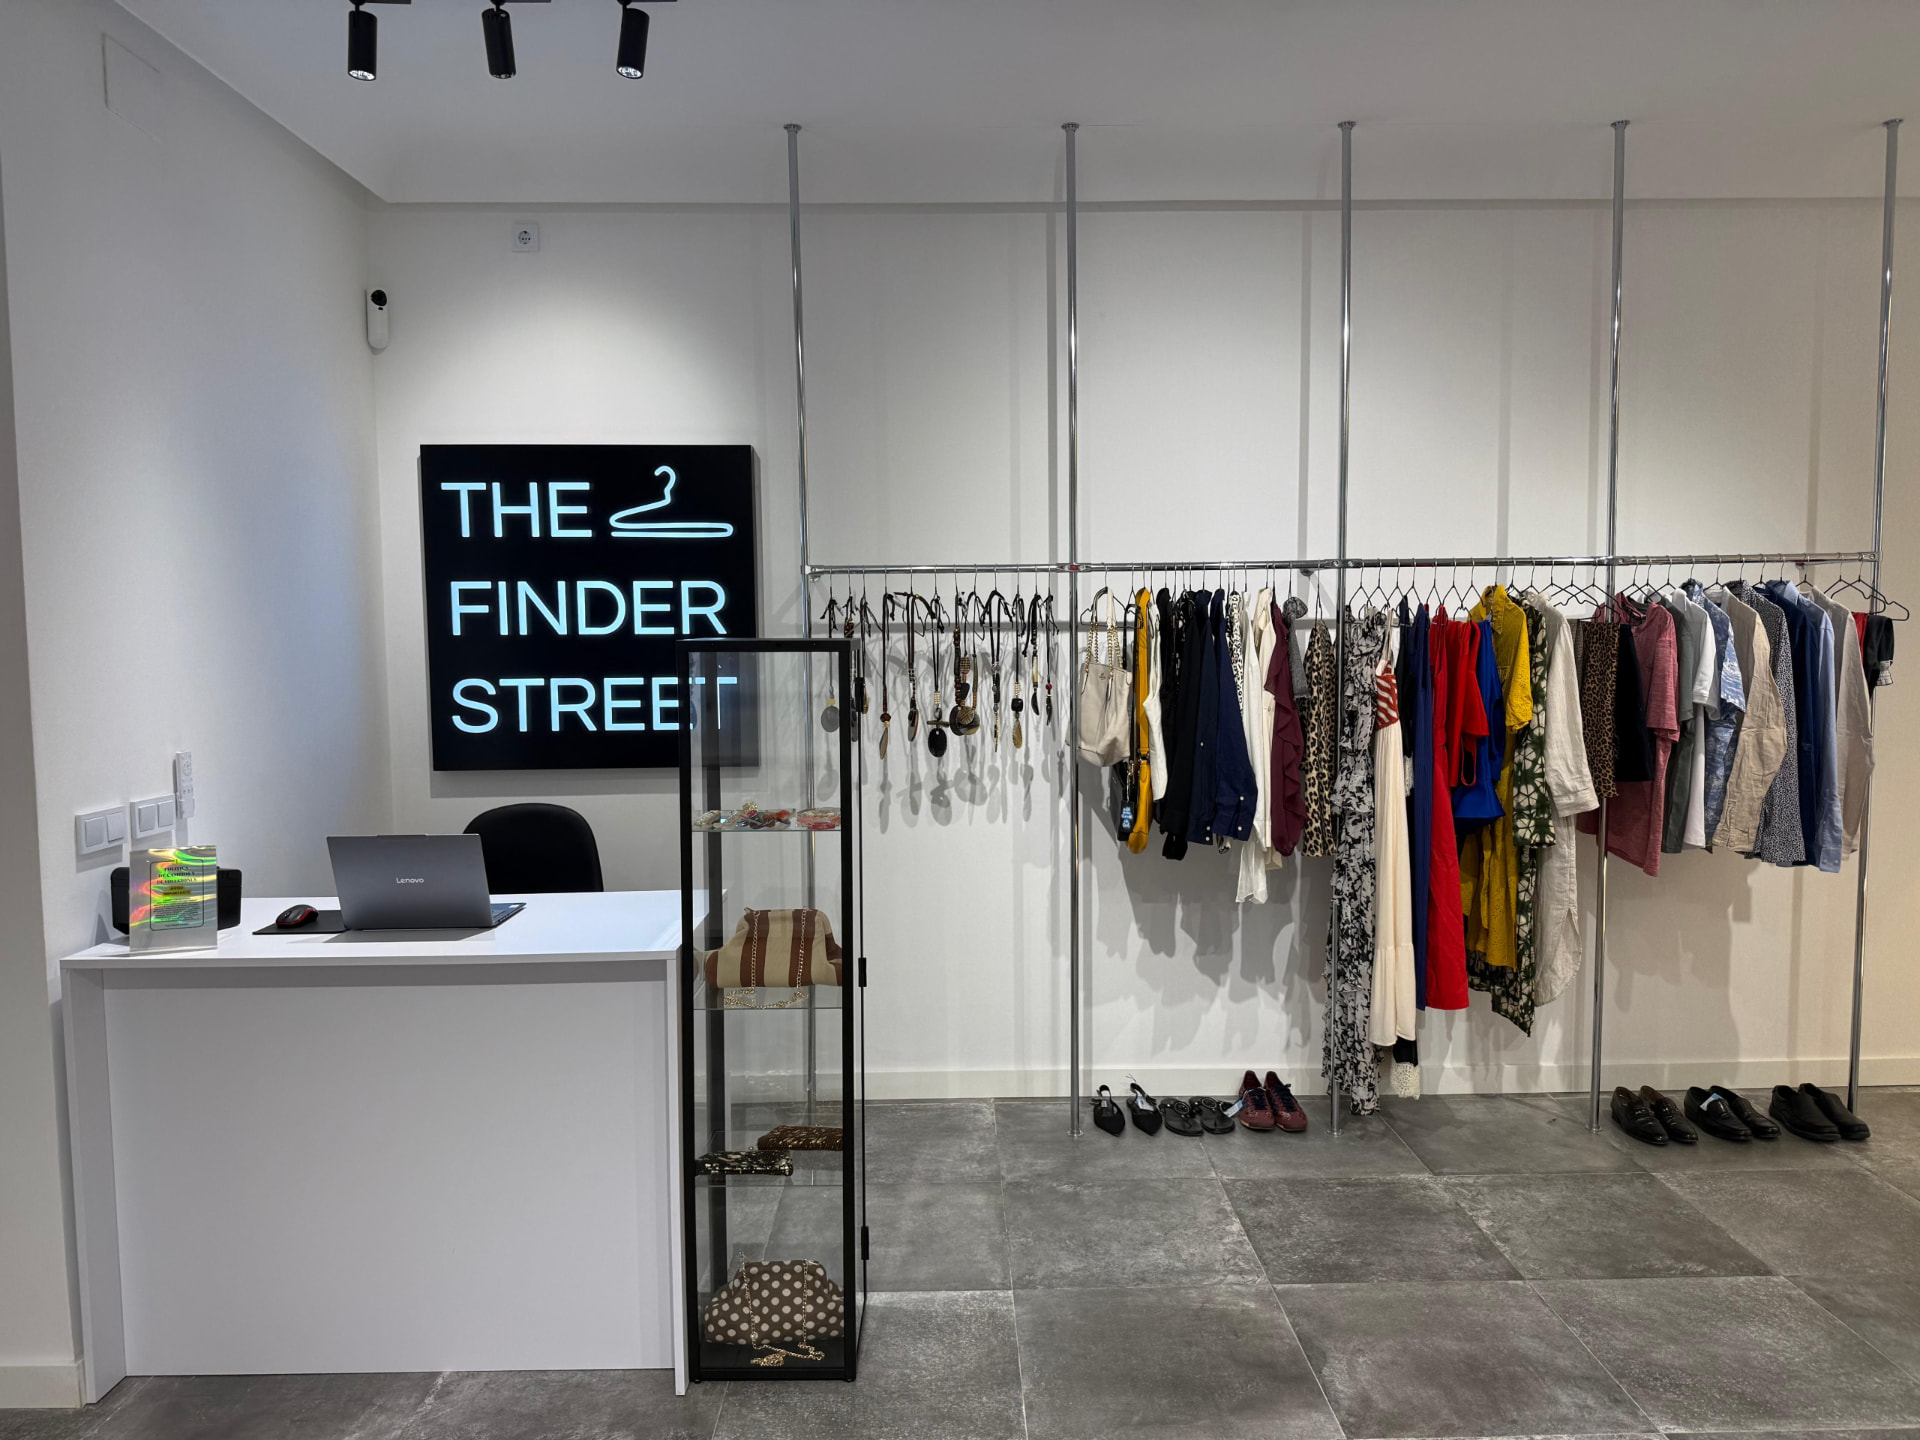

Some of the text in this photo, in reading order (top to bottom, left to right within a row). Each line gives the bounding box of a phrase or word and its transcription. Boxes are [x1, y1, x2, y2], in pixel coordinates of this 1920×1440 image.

[441, 482, 592, 537] THE
[450, 580, 727, 635] FINDER
[452, 676, 737, 733] STREET
